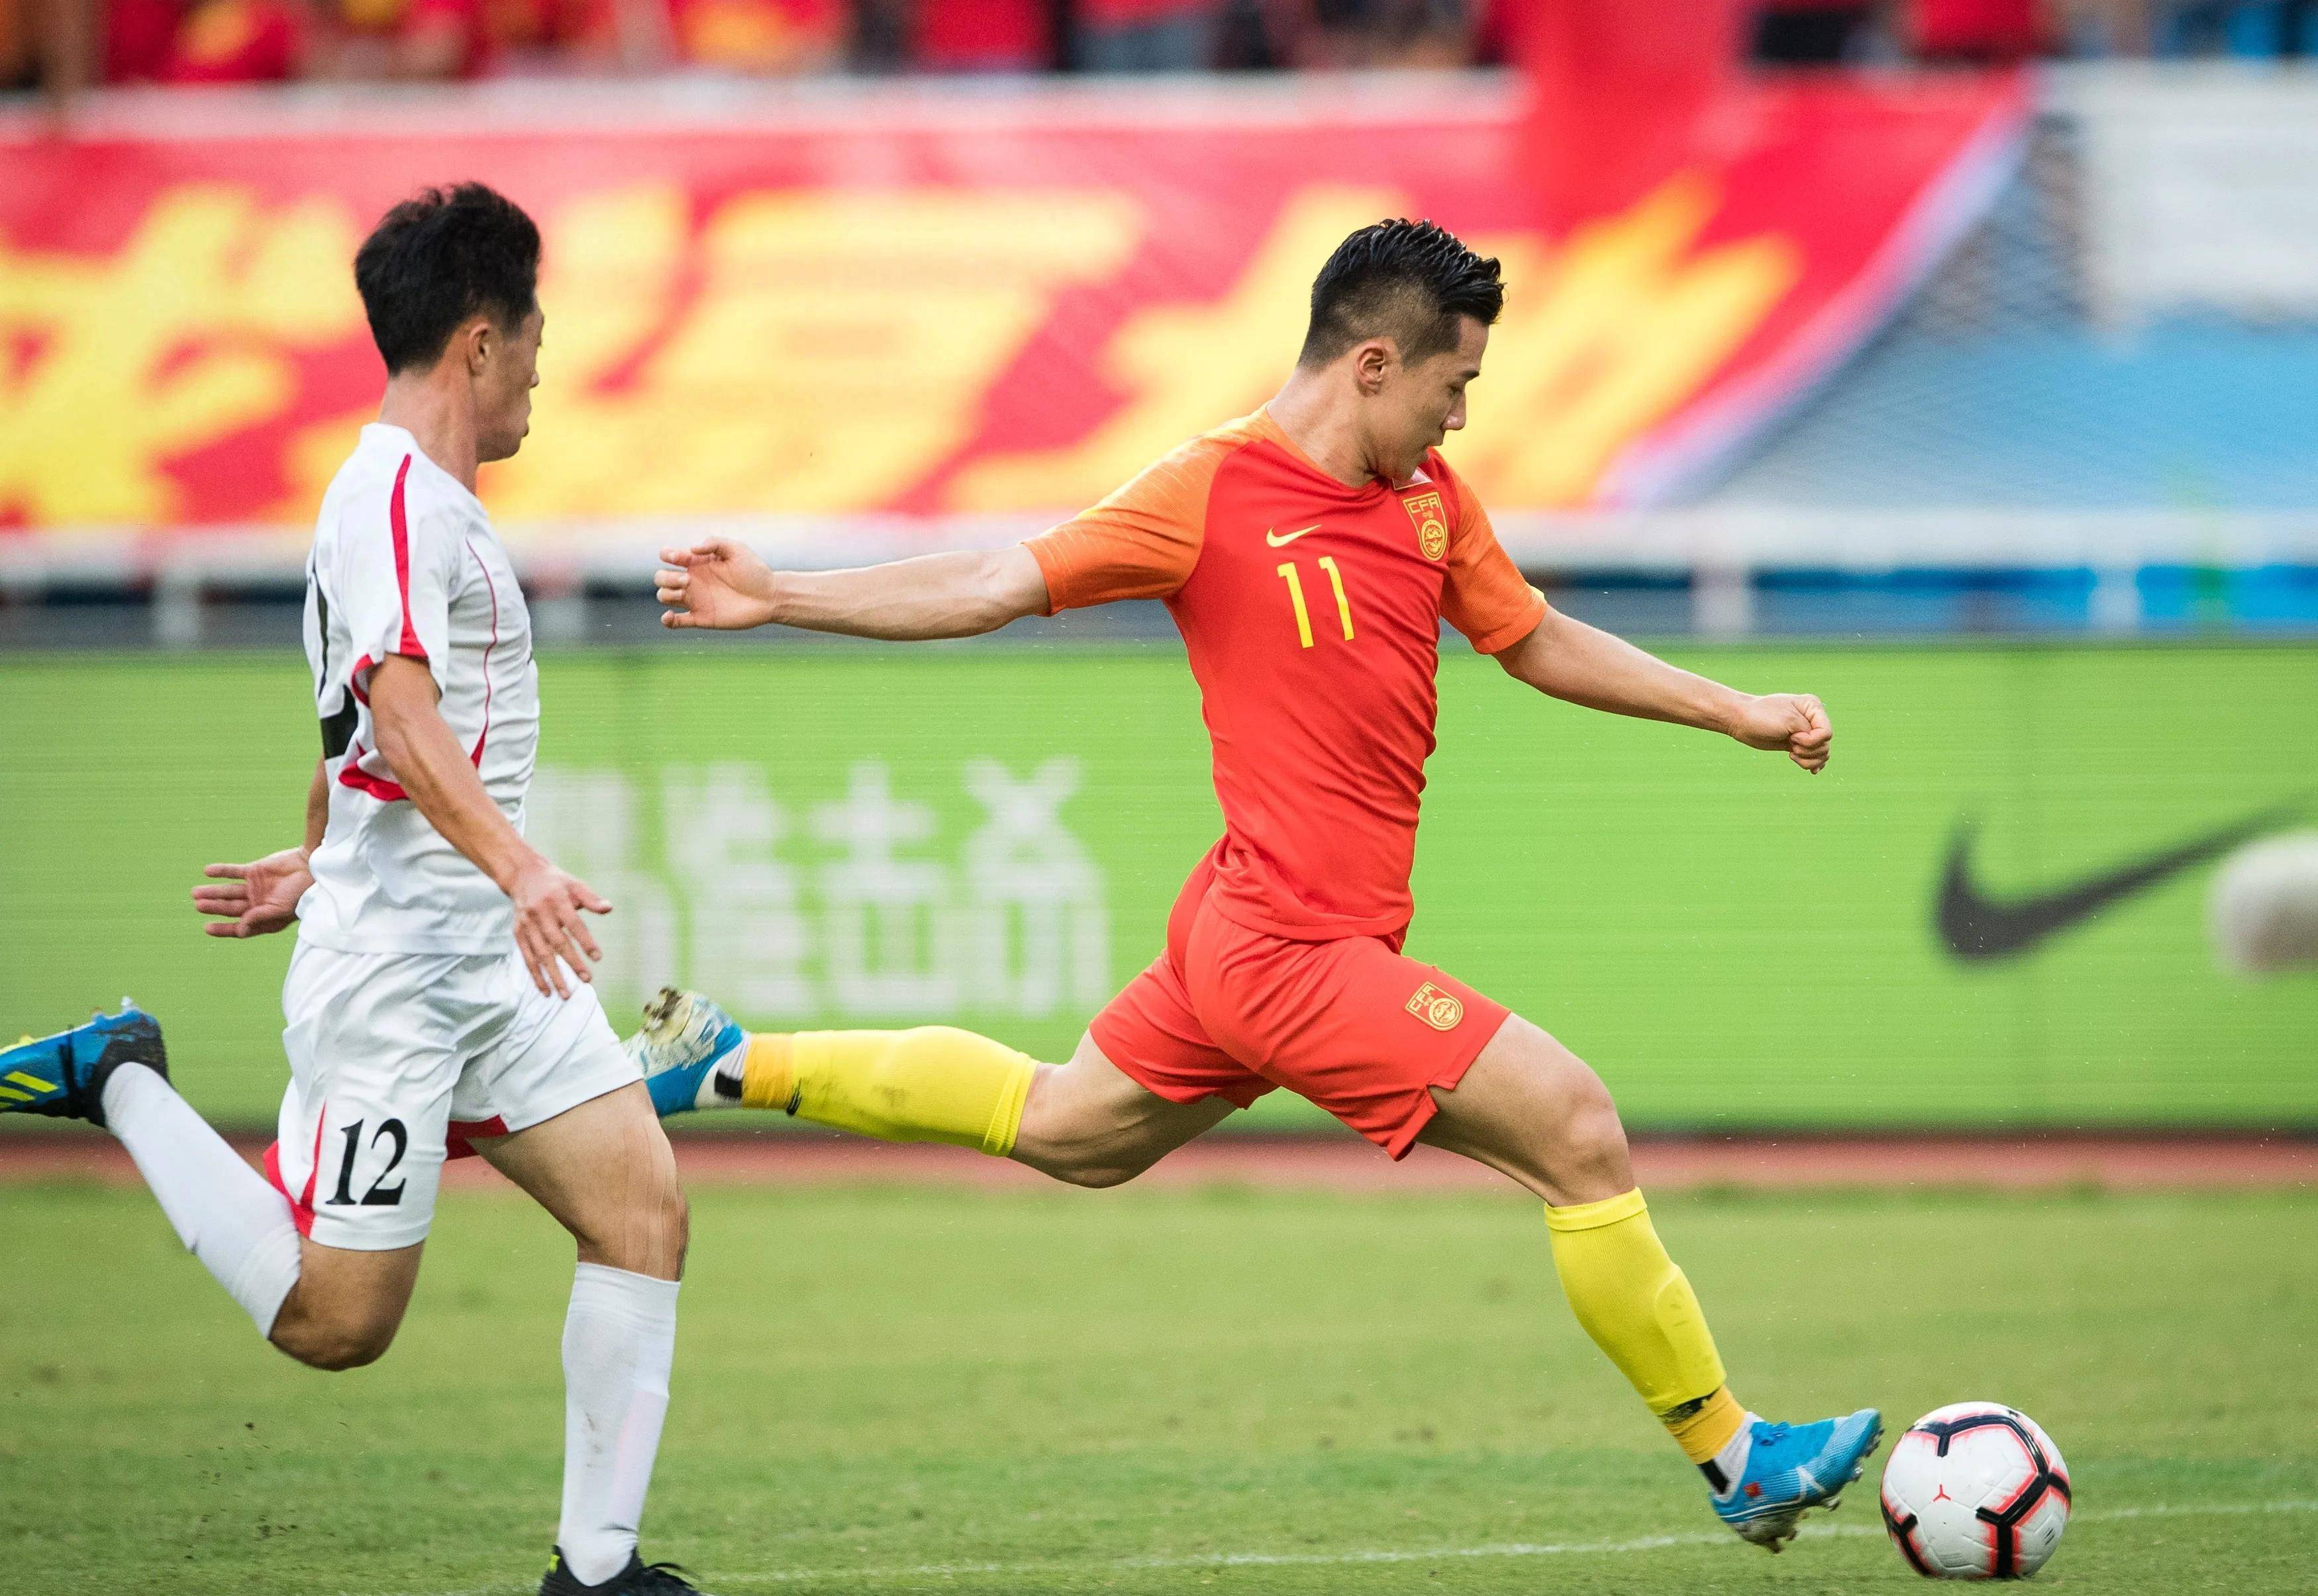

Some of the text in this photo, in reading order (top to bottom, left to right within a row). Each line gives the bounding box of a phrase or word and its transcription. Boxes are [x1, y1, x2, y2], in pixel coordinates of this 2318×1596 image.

[1407, 497, 1440, 514] CFA
[1277, 556, 1355, 648] 11
[1409, 984, 1436, 1012] CFA
[325, 1118, 408, 1205] 12
